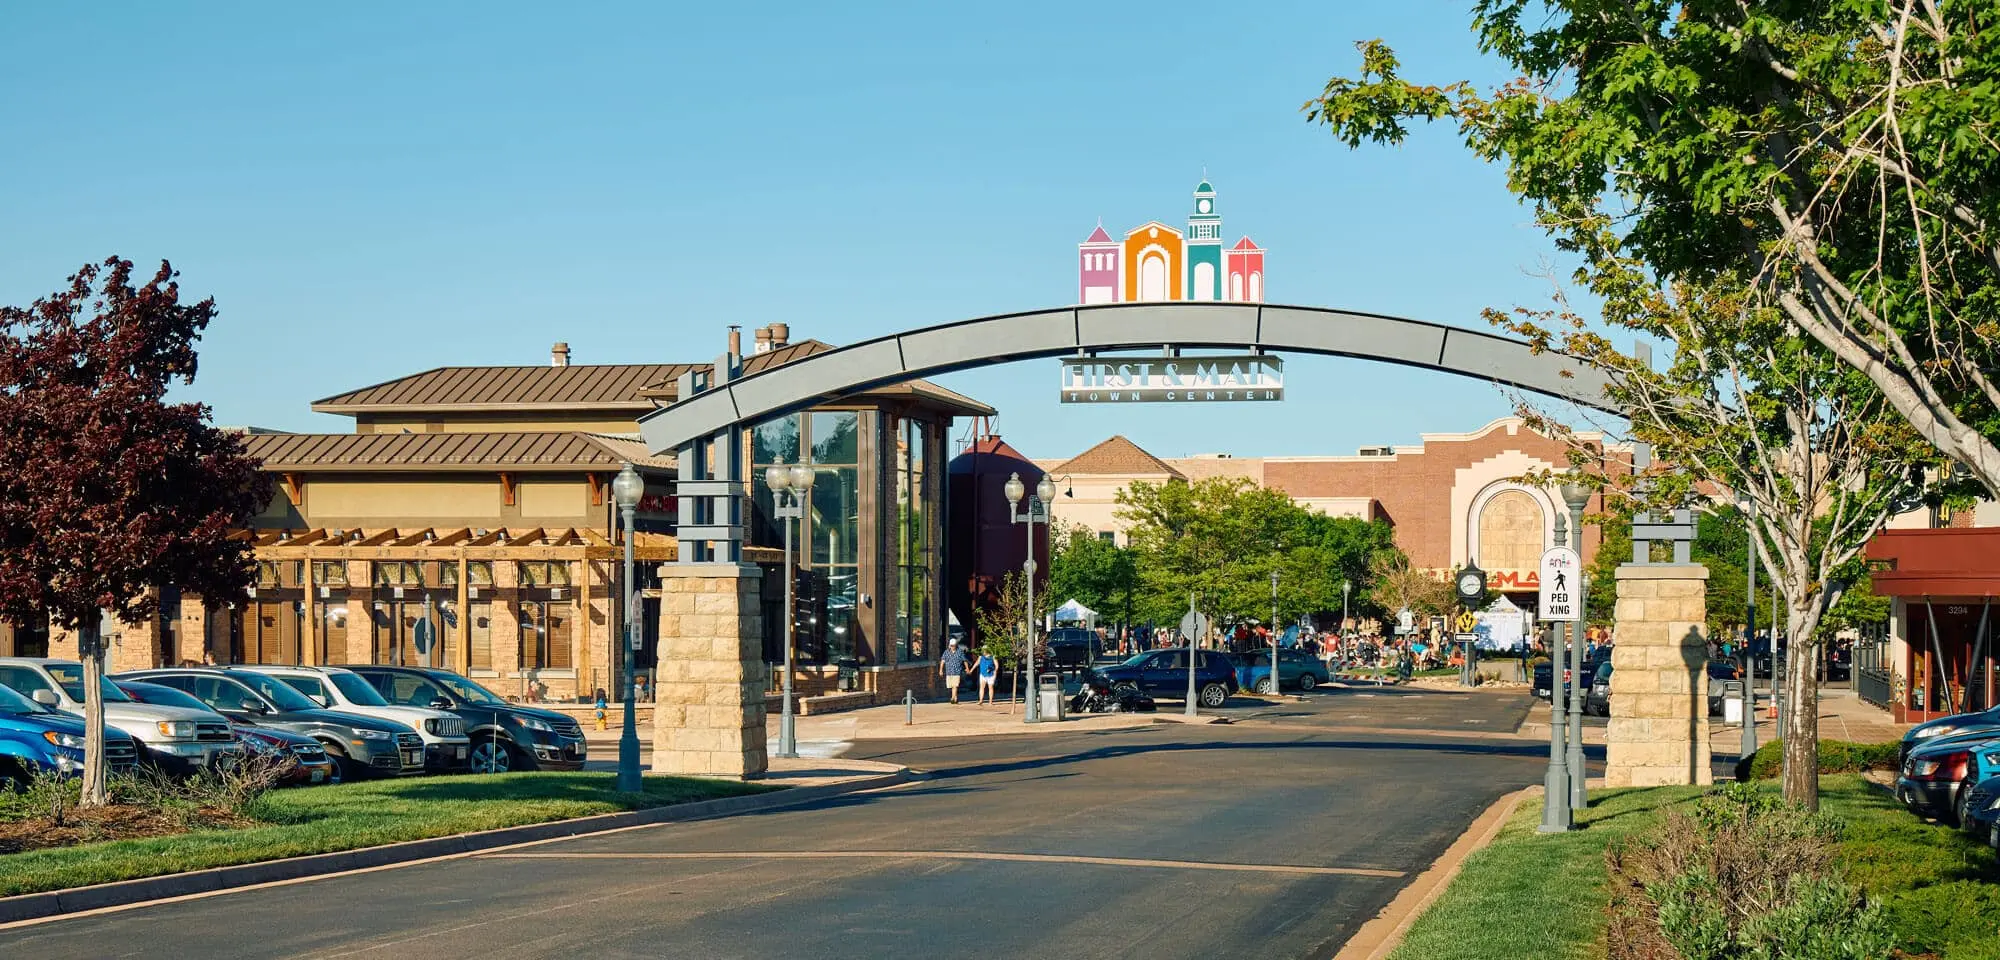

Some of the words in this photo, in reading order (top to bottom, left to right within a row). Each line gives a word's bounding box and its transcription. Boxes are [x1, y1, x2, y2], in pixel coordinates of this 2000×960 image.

[1064, 363, 1154, 386] FIRST
[1163, 363, 1184, 386] &
[1193, 362, 1282, 386] MAIN
[1070, 392, 1140, 401] TOWN
[1167, 390, 1274, 401] CENTER
[1551, 593, 1568, 603] PED
[1549, 605, 1570, 615] XING
